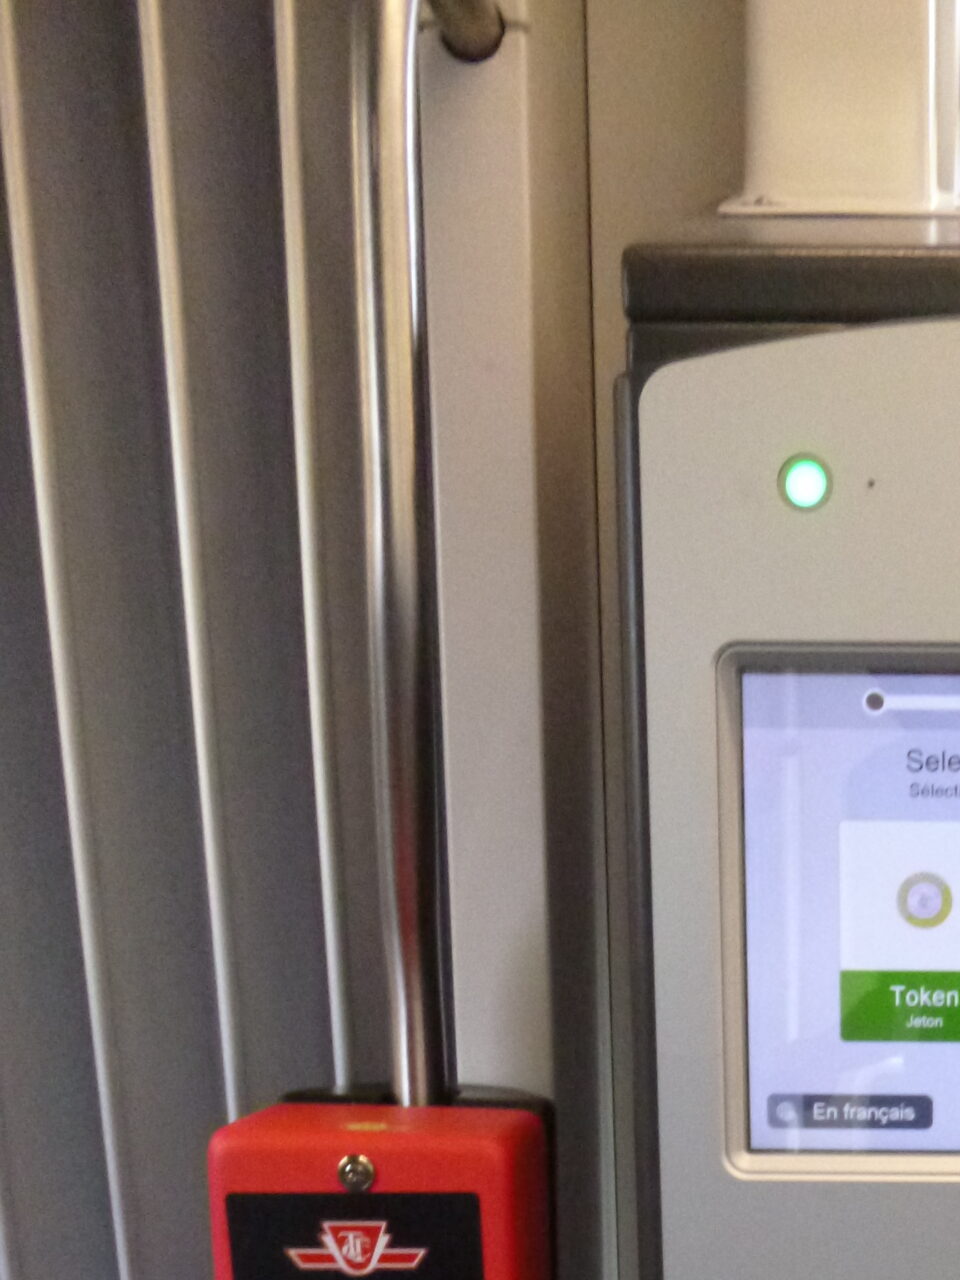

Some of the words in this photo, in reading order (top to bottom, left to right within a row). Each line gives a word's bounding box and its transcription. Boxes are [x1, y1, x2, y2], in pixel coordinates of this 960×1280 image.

[889, 984, 960, 1008] Token
[905, 1014, 944, 1029] Jeton
[813, 1102, 838, 1121] En
[843, 1101, 916, 1125] français
